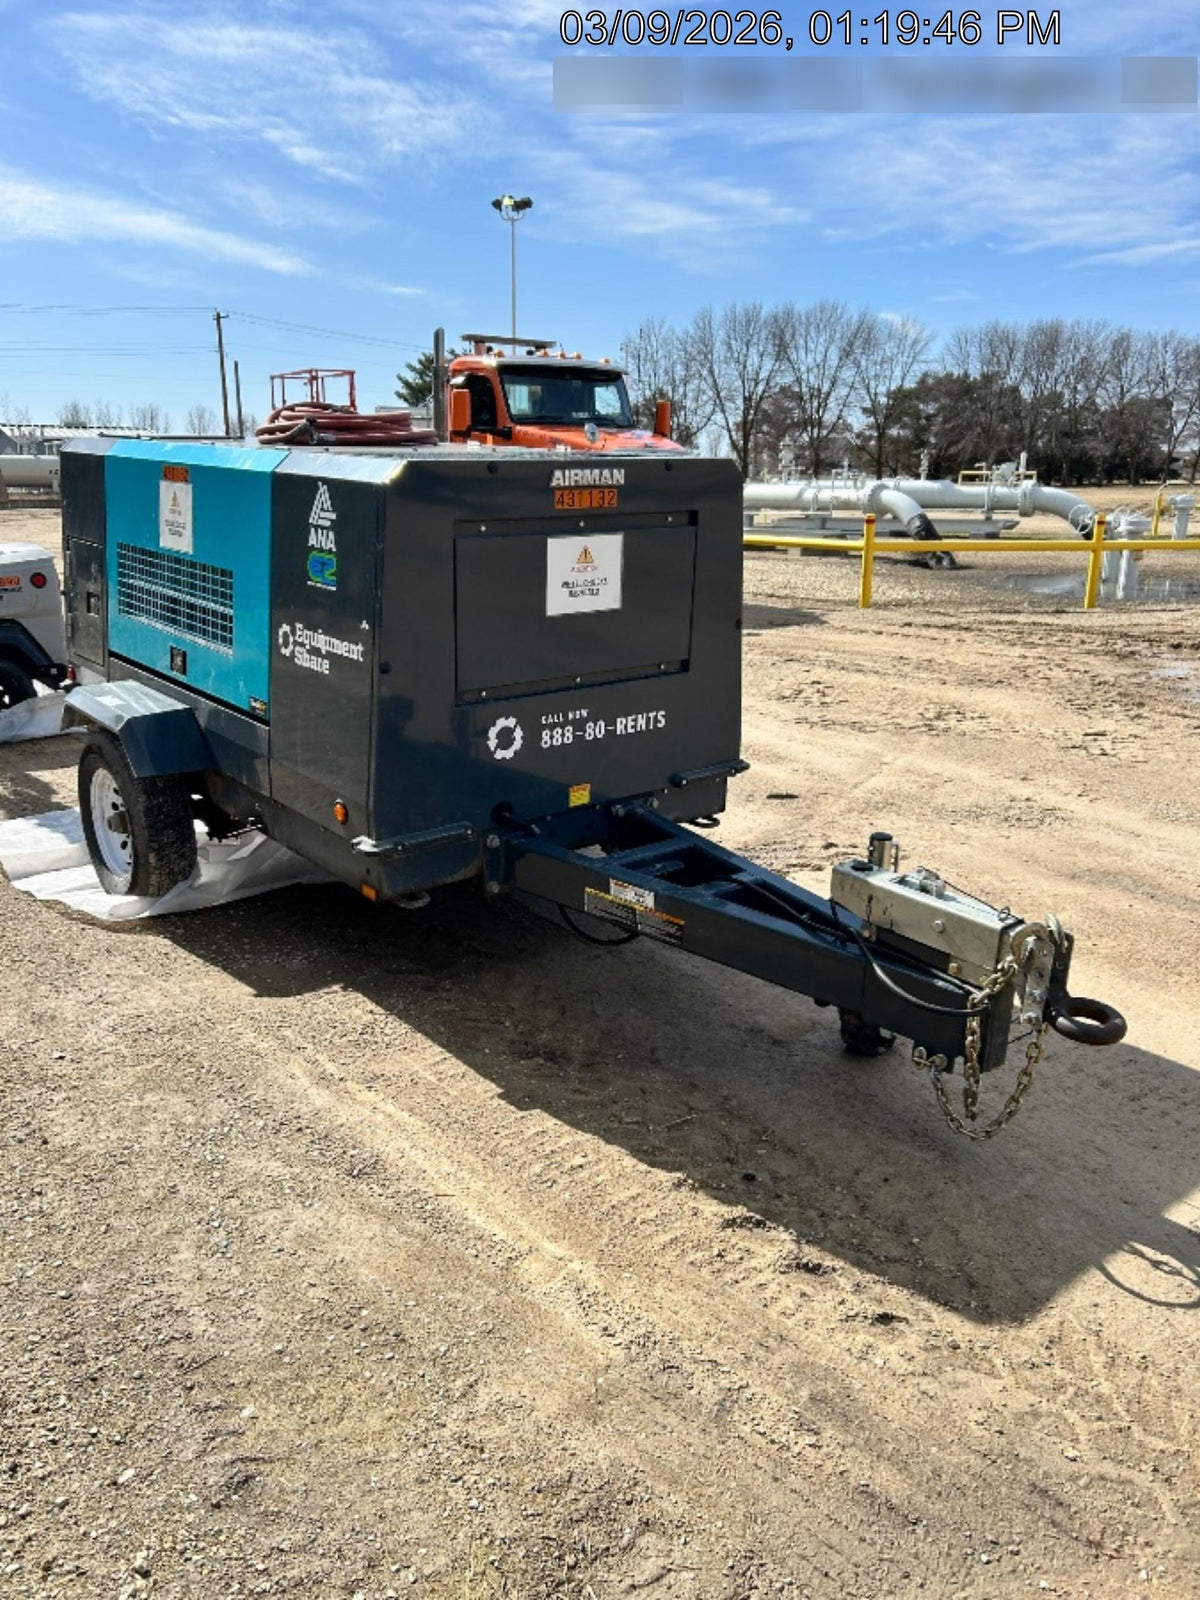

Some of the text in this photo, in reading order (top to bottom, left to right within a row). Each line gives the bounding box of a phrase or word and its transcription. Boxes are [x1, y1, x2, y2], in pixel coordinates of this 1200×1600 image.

[550, 468, 625, 487] AIRMAN
[307, 527, 337, 552] ANA
[294, 621, 364, 662] Equipment
[294, 644, 330, 675] Share
[540, 710, 667, 749] 888-80-RENTS
[541, 708, 590, 725] CALL NOW
